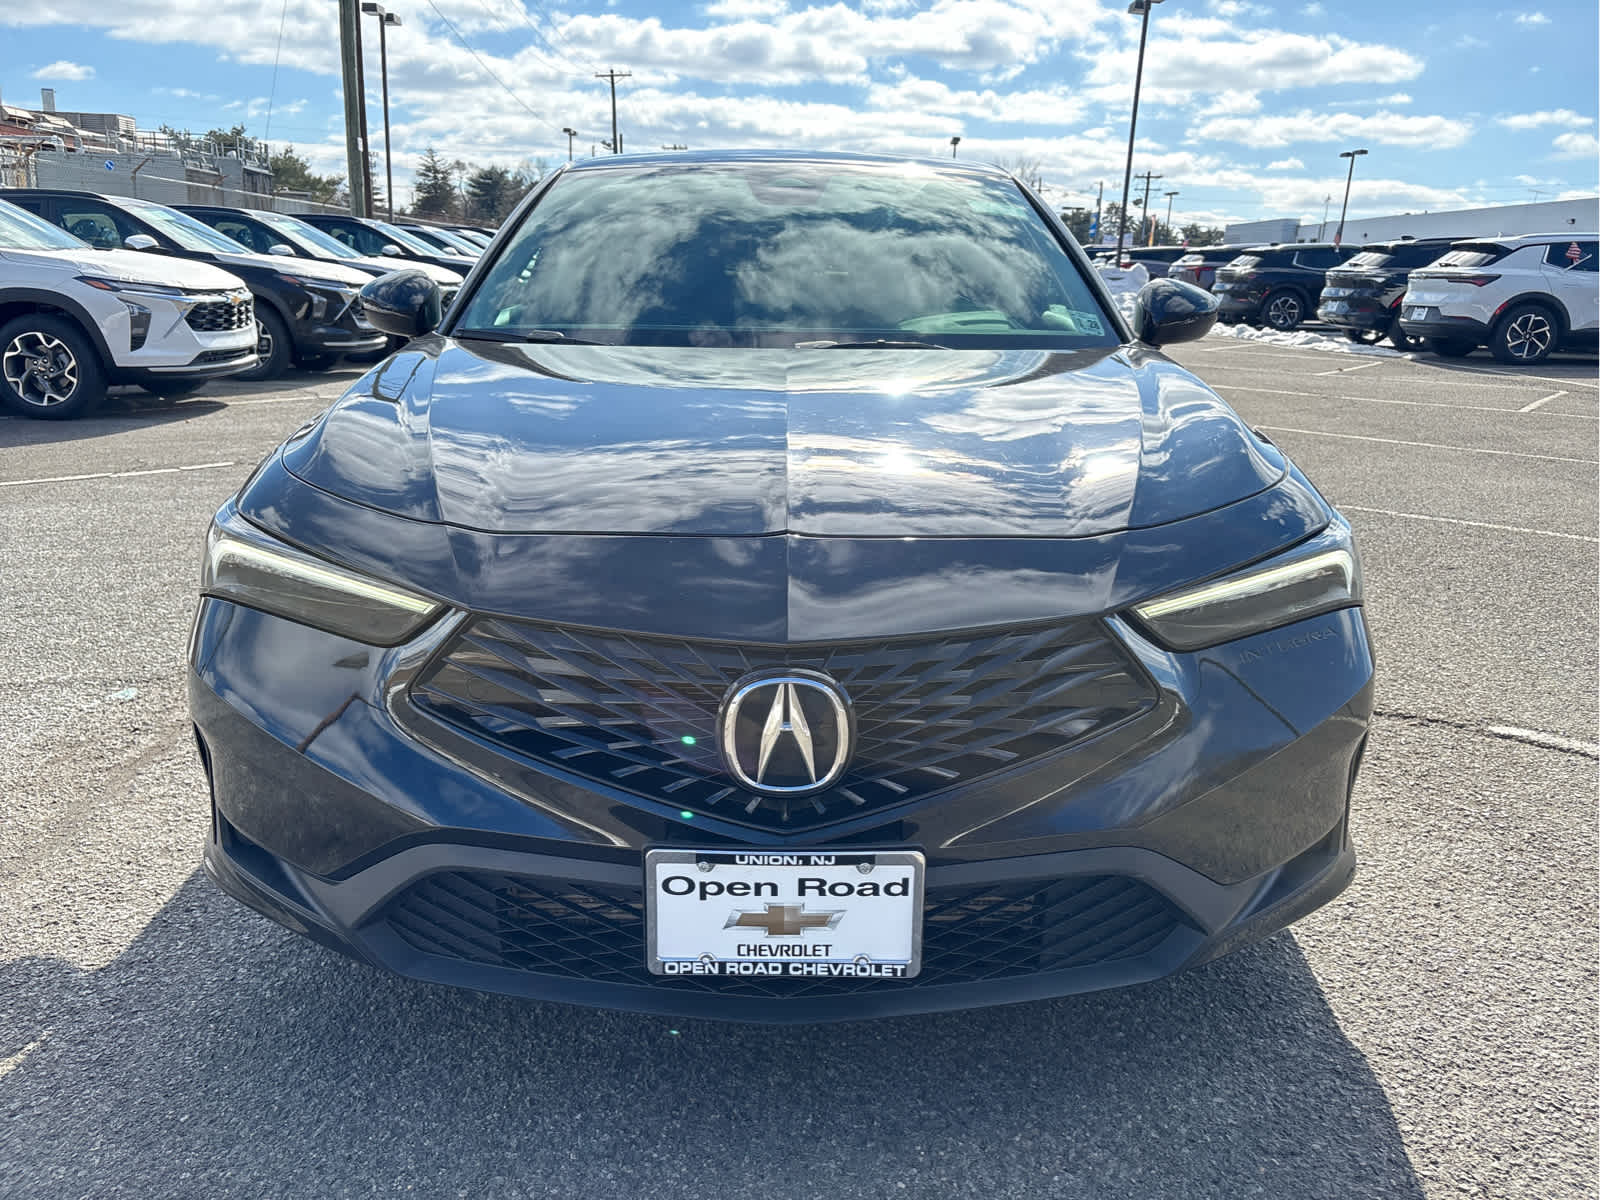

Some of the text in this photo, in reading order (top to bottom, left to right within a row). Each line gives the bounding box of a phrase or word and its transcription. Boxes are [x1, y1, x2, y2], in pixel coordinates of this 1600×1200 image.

[1239, 625, 1338, 665] INTEGRA
[810, 854, 835, 865] NJ
[661, 875, 909, 900] Open Road
[736, 943, 832, 957] CHEVROLET
[664, 962, 905, 976] OPEN ROAD CHEVROLET
